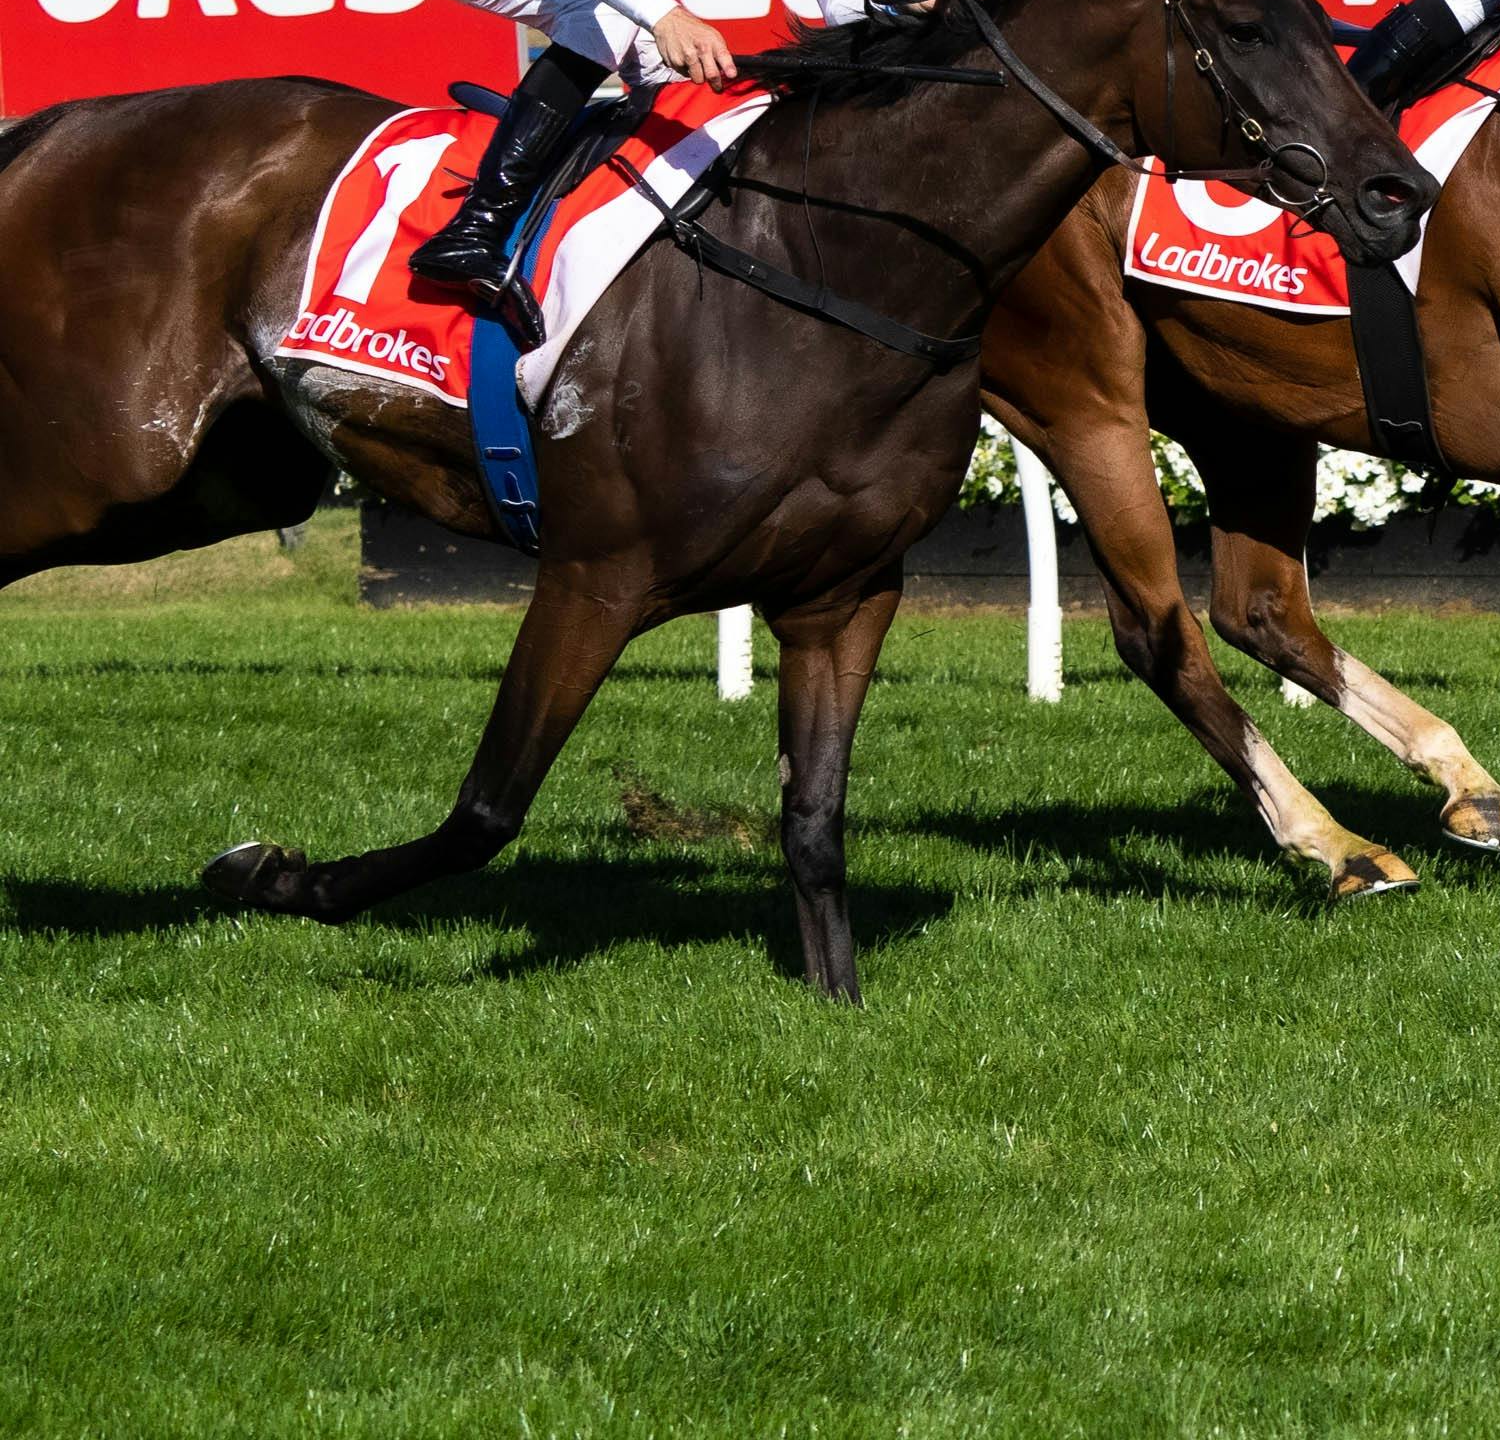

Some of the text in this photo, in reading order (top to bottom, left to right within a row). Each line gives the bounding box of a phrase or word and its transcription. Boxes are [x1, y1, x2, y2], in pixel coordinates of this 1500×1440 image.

[332, 132, 458, 305] 1
[1140, 231, 1308, 295] Ladbrokes
[288, 308, 451, 382] adbrokes
